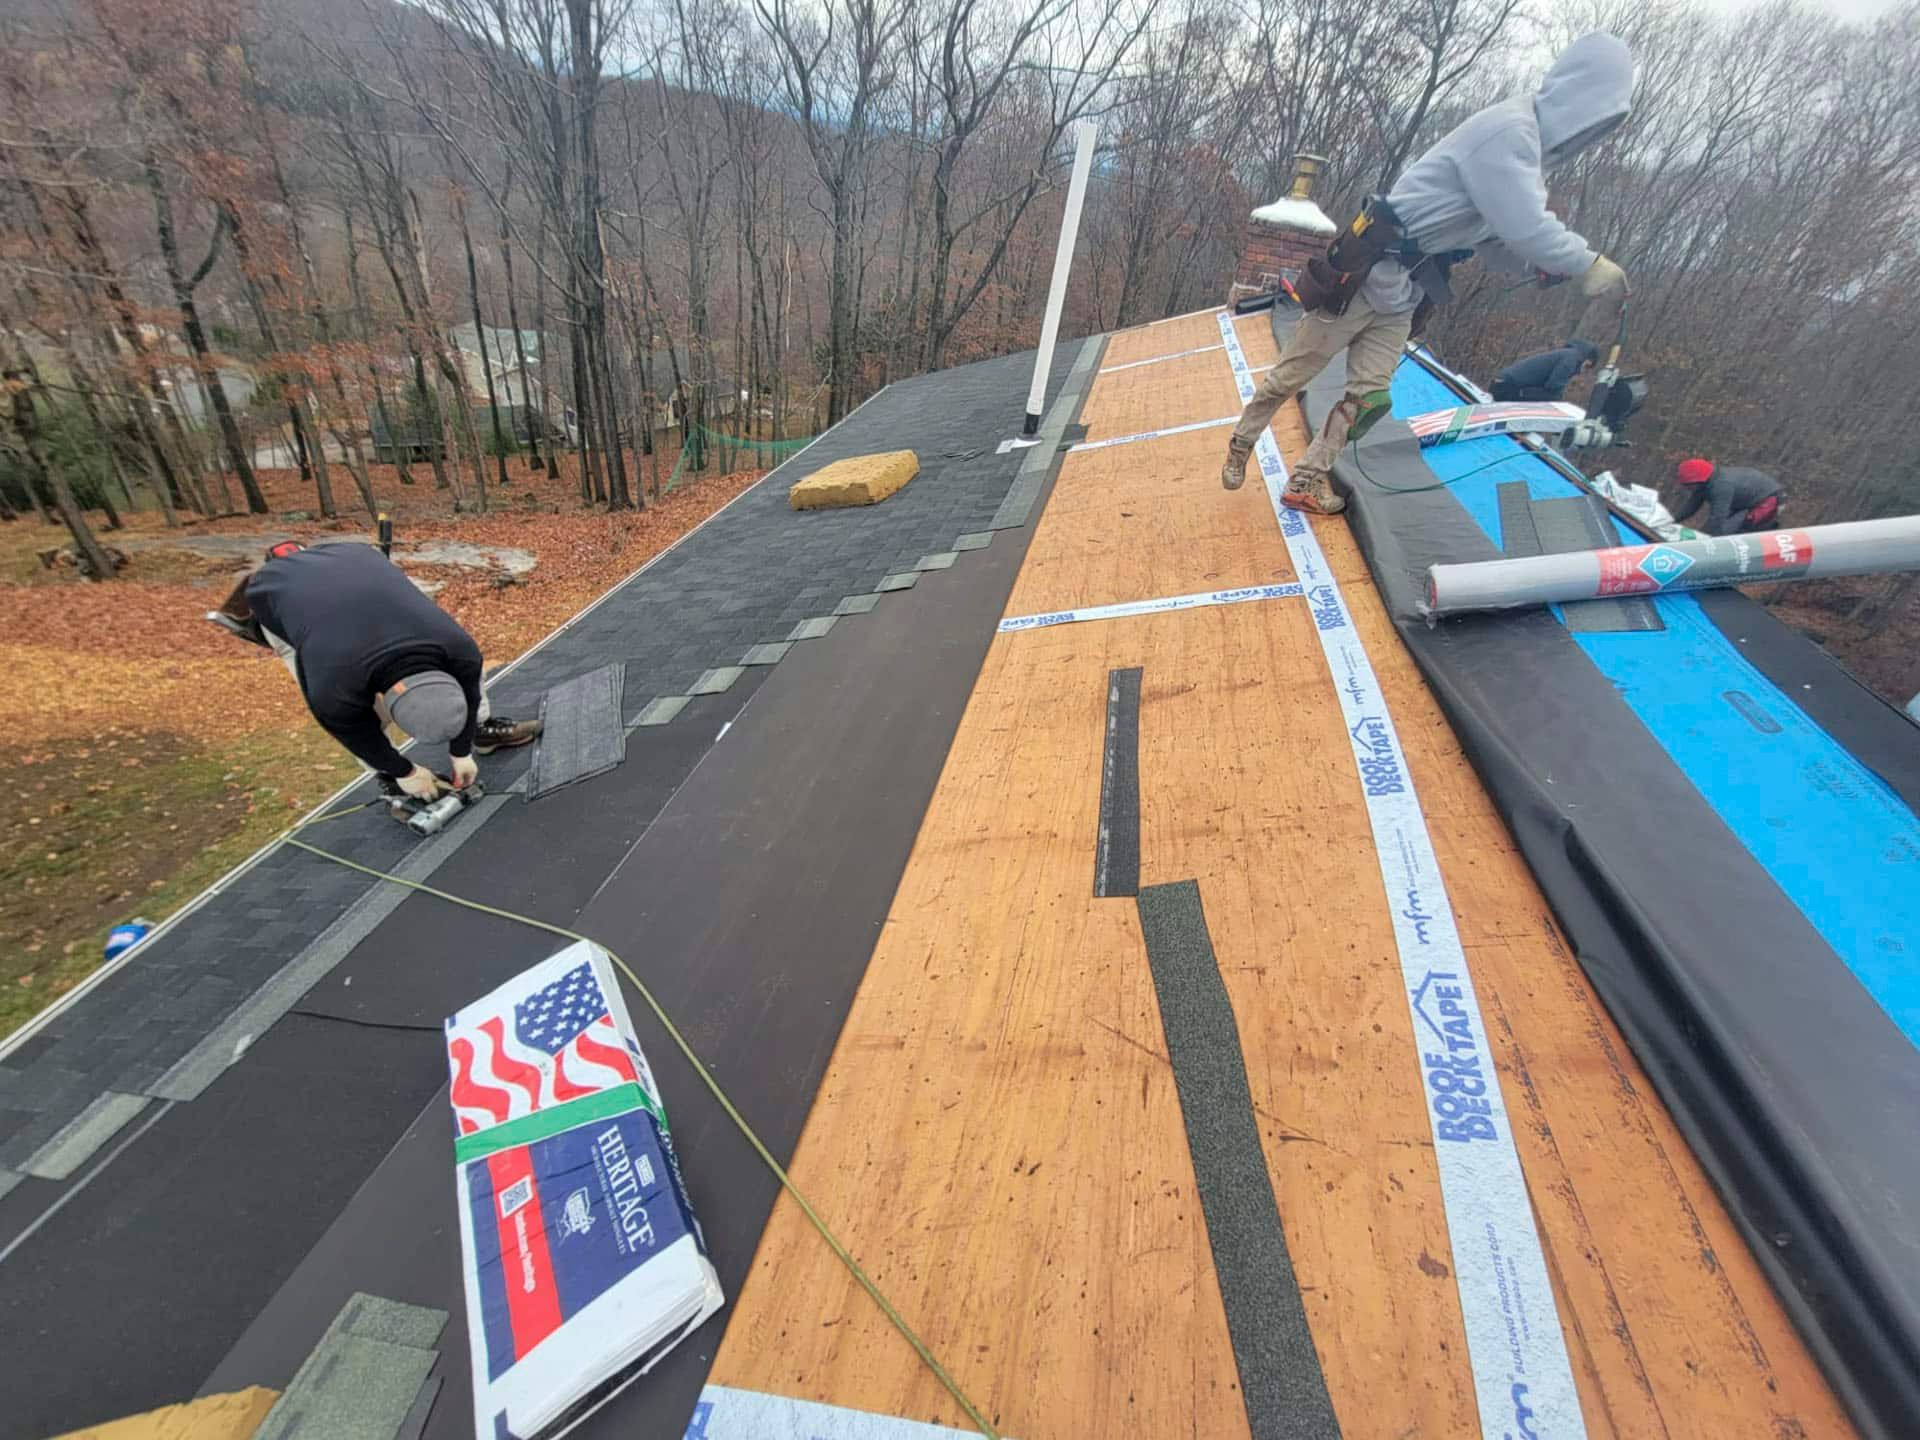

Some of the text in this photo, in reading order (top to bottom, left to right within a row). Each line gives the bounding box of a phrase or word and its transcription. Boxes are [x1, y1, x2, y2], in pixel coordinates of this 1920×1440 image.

[1775, 535, 1797, 563] GAF
[1359, 757, 1388, 796] ROOF
[1402, 890, 1432, 944] mfm
[1424, 1052, 1471, 1143] ROOF
[1492, 1254, 1513, 1314] PRODUCTS
[1504, 1317, 1525, 1375] BUILDING
